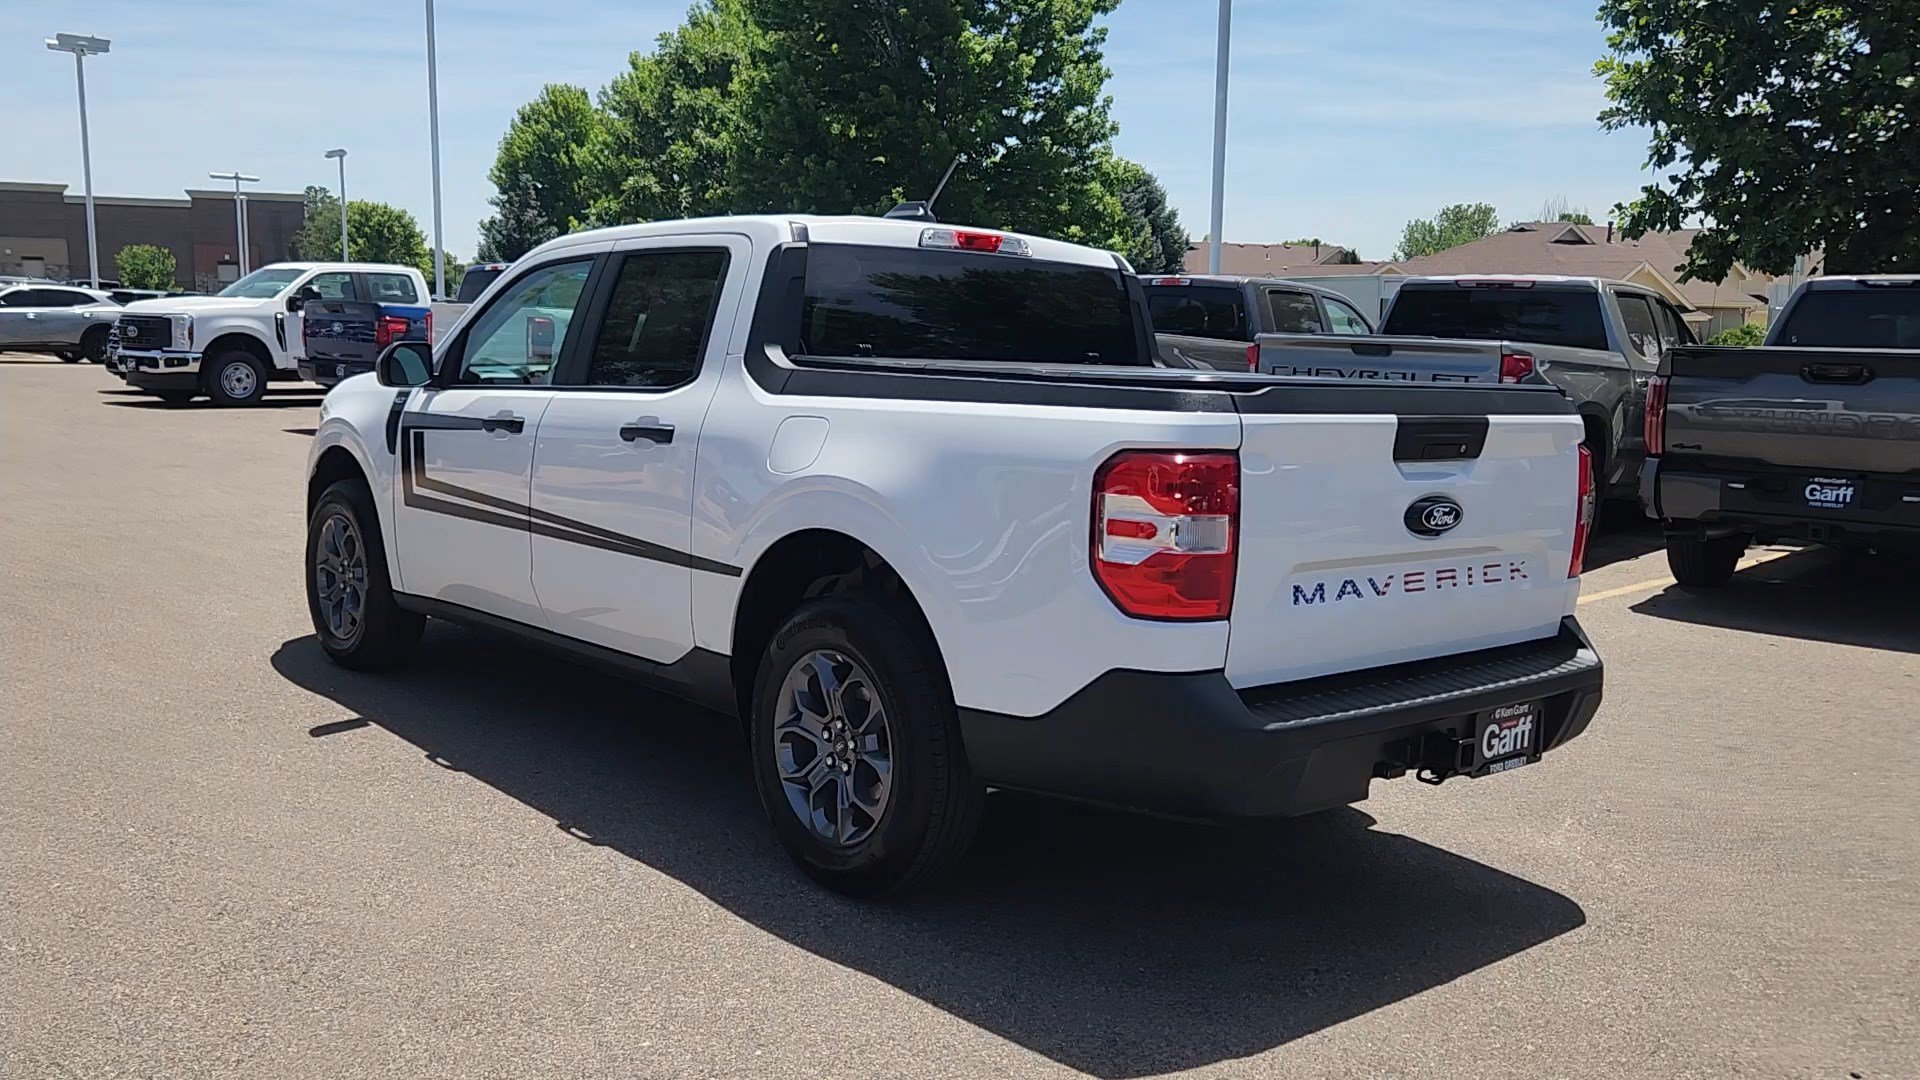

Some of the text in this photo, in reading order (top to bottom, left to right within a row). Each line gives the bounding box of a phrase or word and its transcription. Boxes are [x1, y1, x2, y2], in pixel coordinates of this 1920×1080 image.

[1805, 484, 1855, 503] Garff
[1430, 506, 1456, 527] Ford
[1291, 560, 1528, 606] MAVERICK
[1482, 714, 1533, 759] Garff
